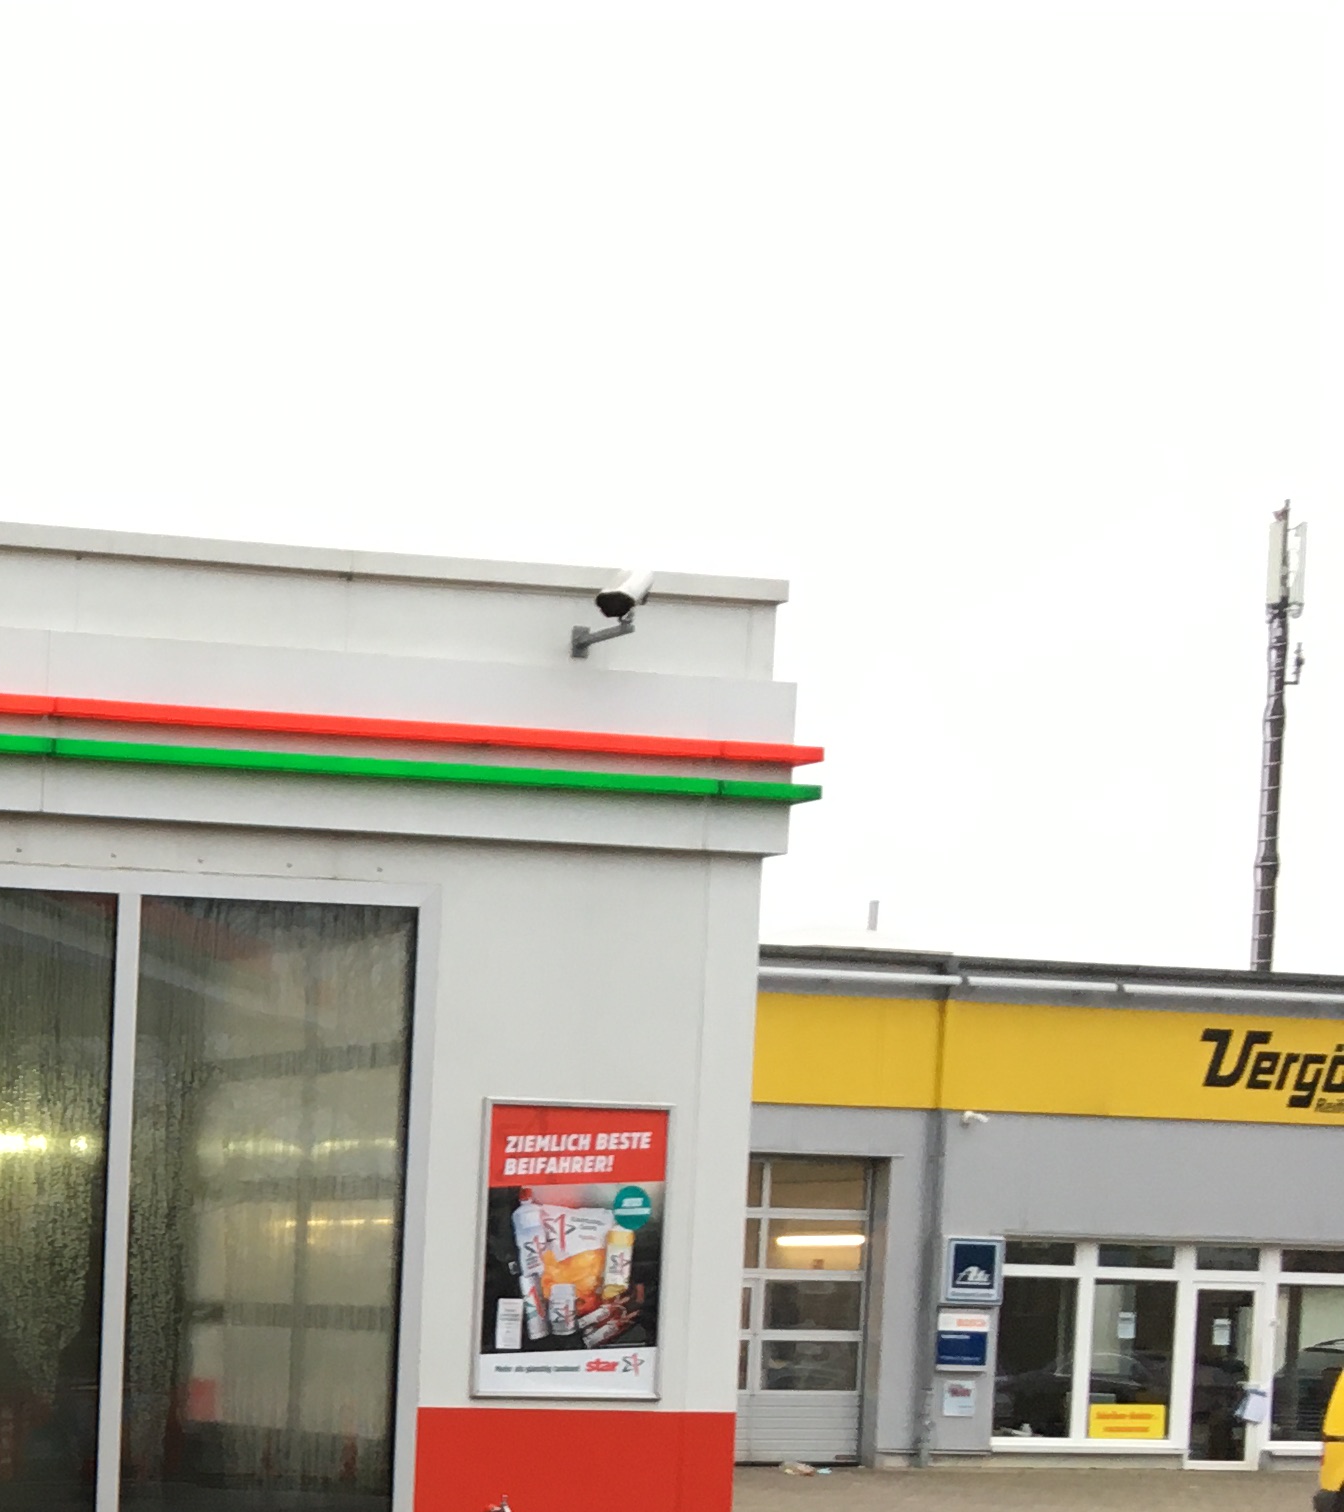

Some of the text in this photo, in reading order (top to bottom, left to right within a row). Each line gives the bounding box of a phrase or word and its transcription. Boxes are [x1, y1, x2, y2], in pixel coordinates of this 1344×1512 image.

[505, 1132, 653, 1154] ZIEMLICH BESTE
[504, 1155, 615, 1177] BEIFAHRER!
[585, 1358, 619, 1373] star
